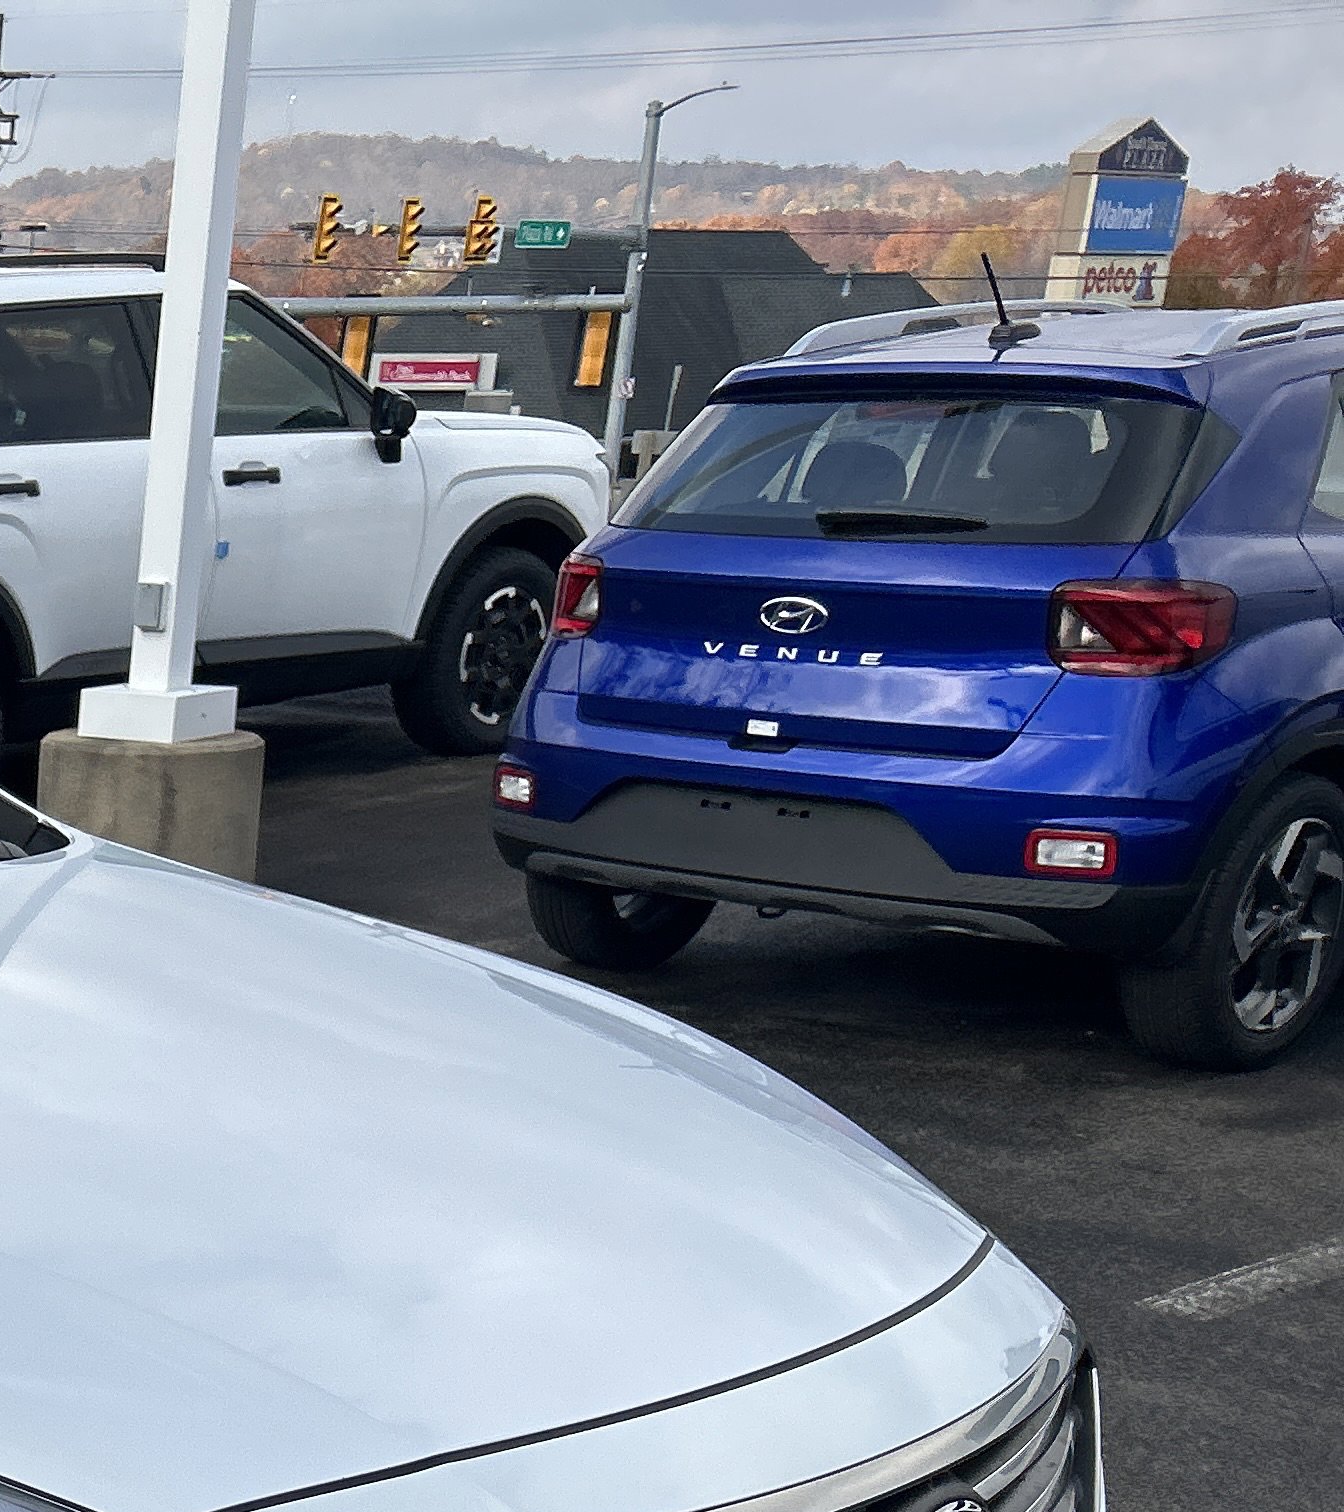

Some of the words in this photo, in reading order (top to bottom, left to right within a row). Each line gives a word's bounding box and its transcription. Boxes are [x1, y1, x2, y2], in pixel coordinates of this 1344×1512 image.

[1093, 200, 1153, 230] Walmart
[1082, 264, 1137, 298] petco
[703, 641, 883, 666] VENUE
